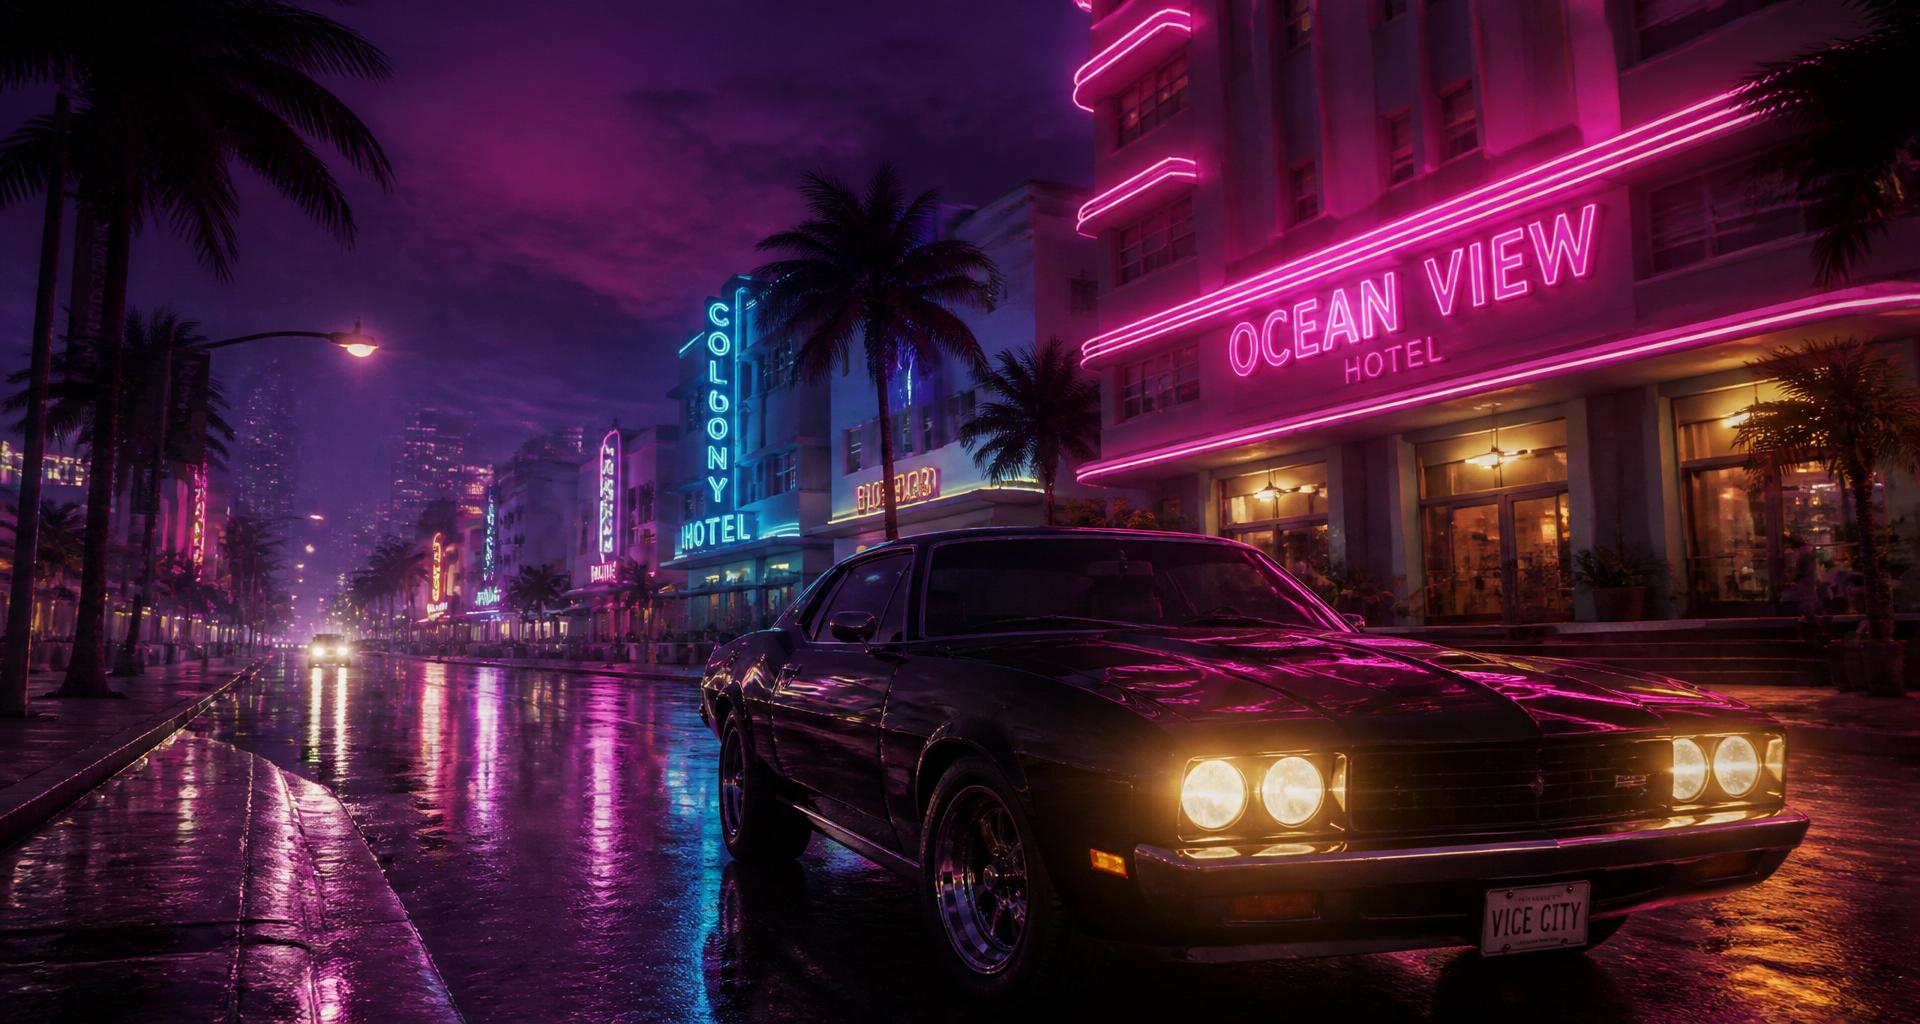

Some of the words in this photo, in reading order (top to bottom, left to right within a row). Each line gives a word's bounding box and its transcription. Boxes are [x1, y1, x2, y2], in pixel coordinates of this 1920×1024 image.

[1229, 271, 1398, 378] OCEAN
[1424, 204, 1597, 316] VIEW
[1344, 336, 1446, 384] HOTEL
[1492, 906, 1533, 937] VICE
[1540, 901, 1582, 932] CITY
